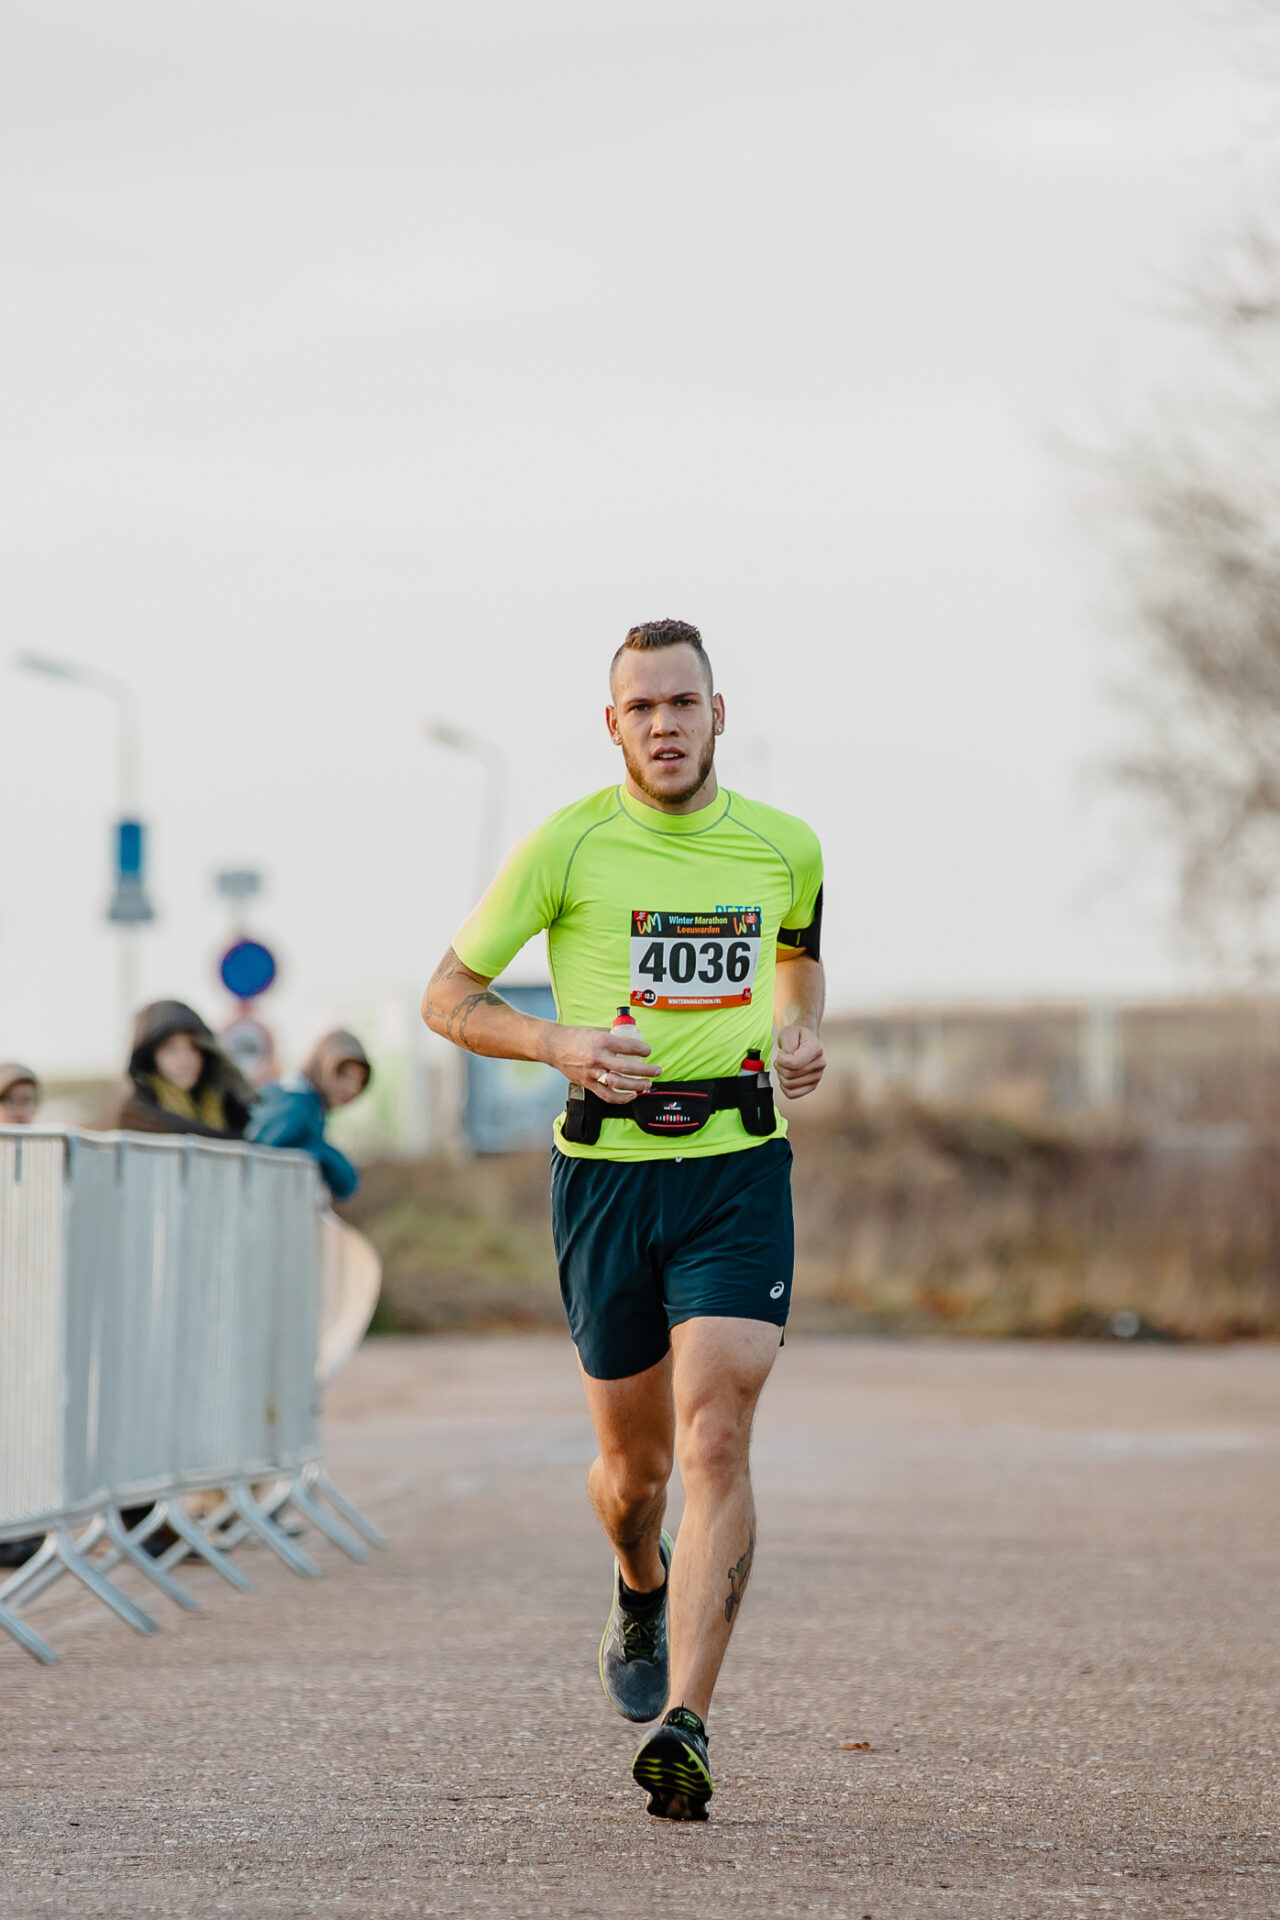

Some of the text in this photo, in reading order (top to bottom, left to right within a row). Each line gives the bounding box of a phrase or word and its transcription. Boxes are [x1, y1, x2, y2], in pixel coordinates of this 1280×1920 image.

[669, 916, 728, 925] Winter Marathon
[677, 925, 720, 934] Leeuwarden
[638, 941, 751, 984] 4036
